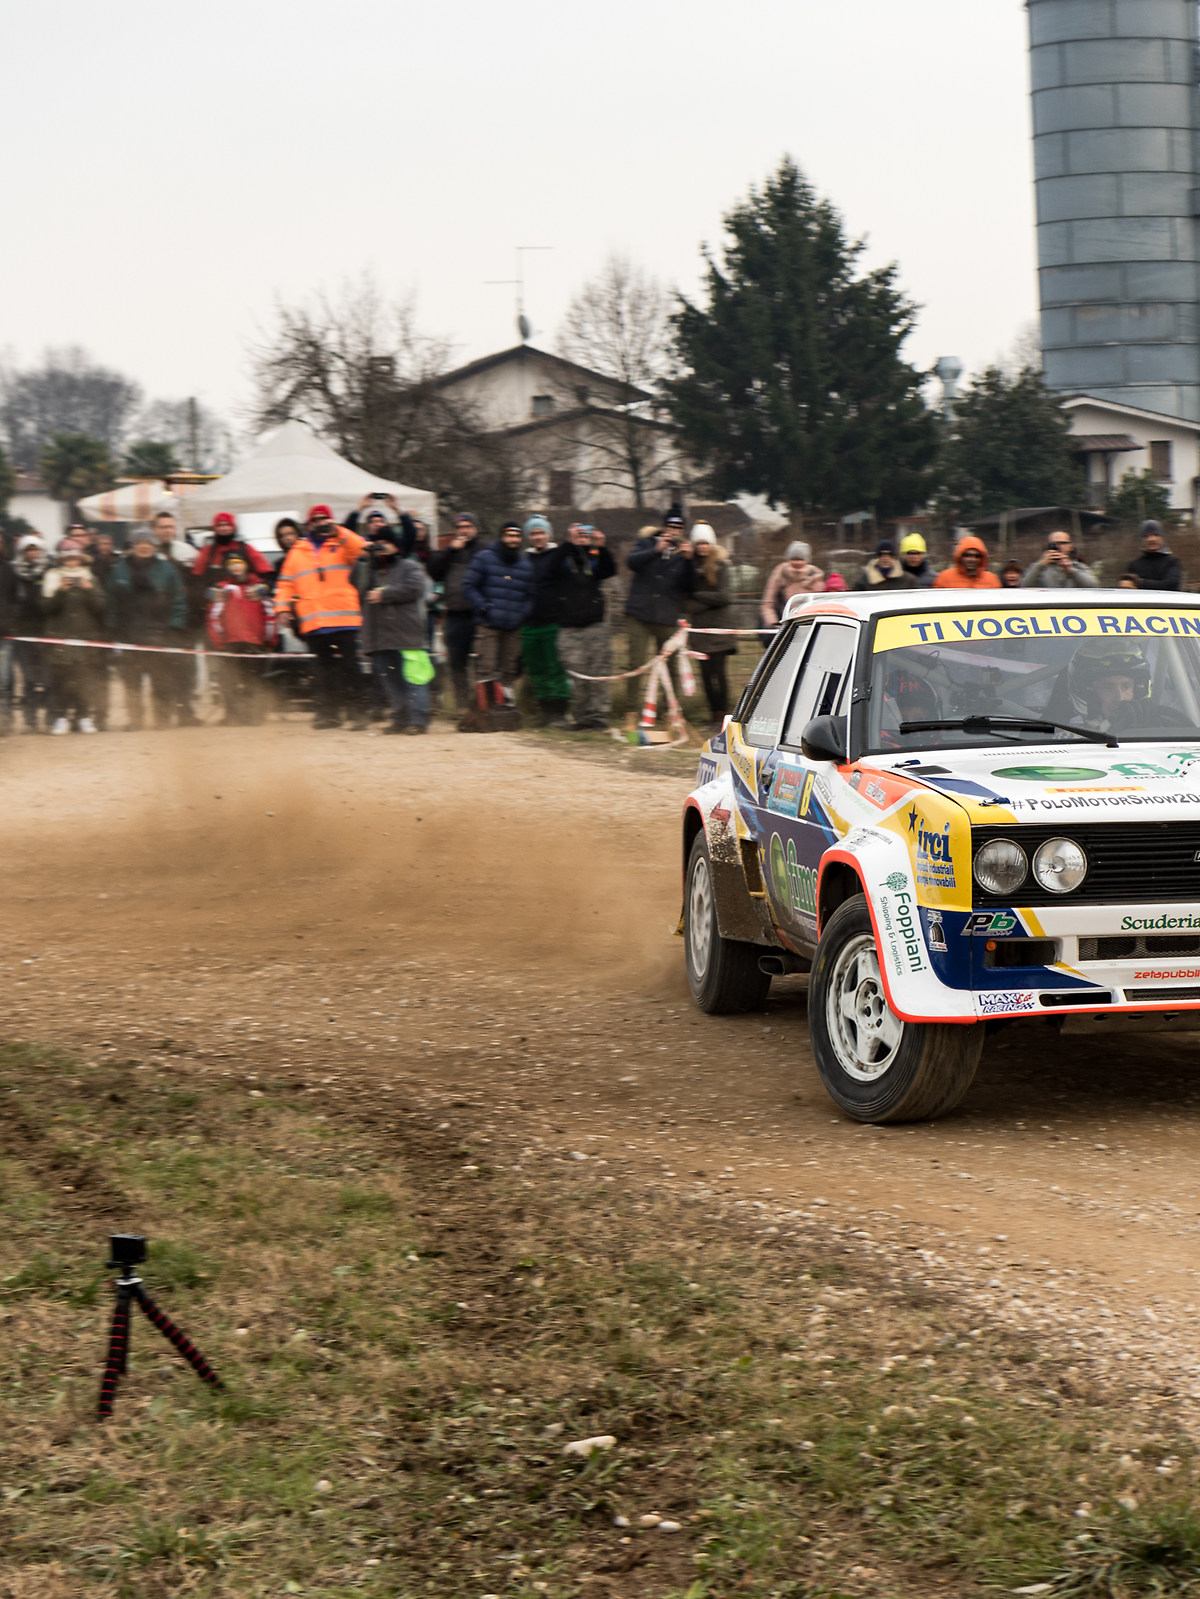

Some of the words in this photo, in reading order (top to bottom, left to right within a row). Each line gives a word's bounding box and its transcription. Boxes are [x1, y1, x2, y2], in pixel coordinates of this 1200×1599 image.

[910, 621, 945, 642] TI
[952, 615, 1088, 639] VOGLIO
[916, 818, 953, 863] irci
[880, 896, 893, 931] Shipping
[890, 941, 903, 976] Logistics
[894, 892, 927, 973] Foppiani
